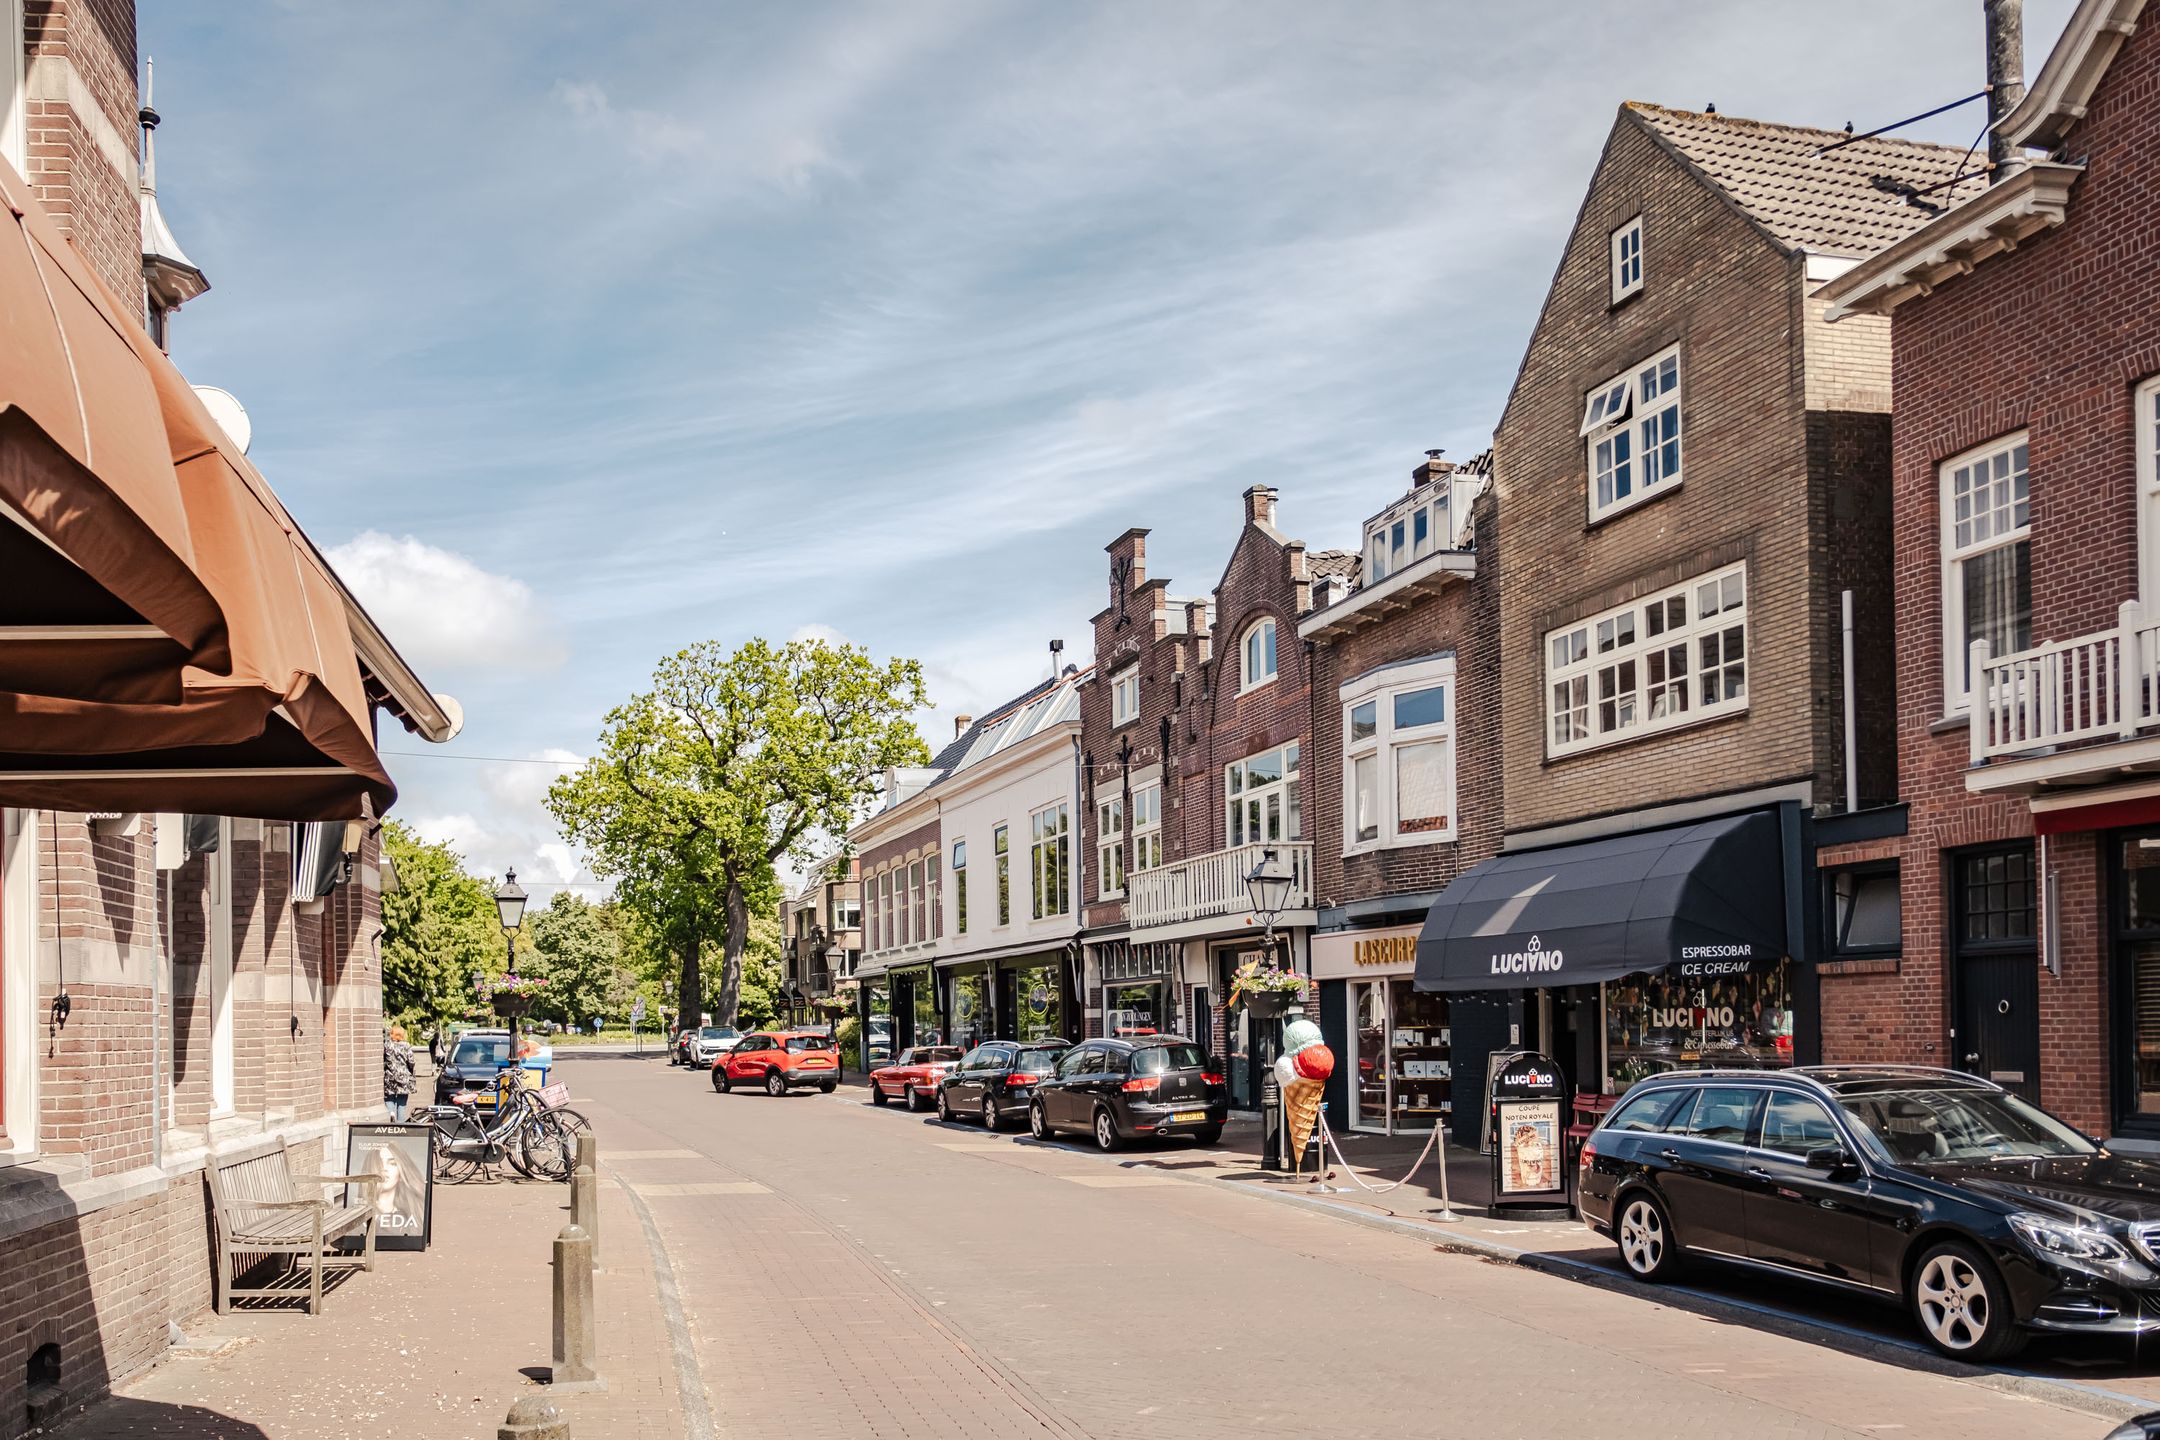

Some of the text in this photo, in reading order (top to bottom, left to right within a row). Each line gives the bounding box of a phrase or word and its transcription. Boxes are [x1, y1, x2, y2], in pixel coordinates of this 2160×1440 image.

[1682, 944, 1751, 959] ESPRESSOBAR
[1491, 950, 1563, 974] LUCIANO
[1681, 961, 1750, 976] ICE CREAM
[1504, 1074, 1553, 1085] LUCIANO
[374, 1126, 407, 1134] AVEDA
